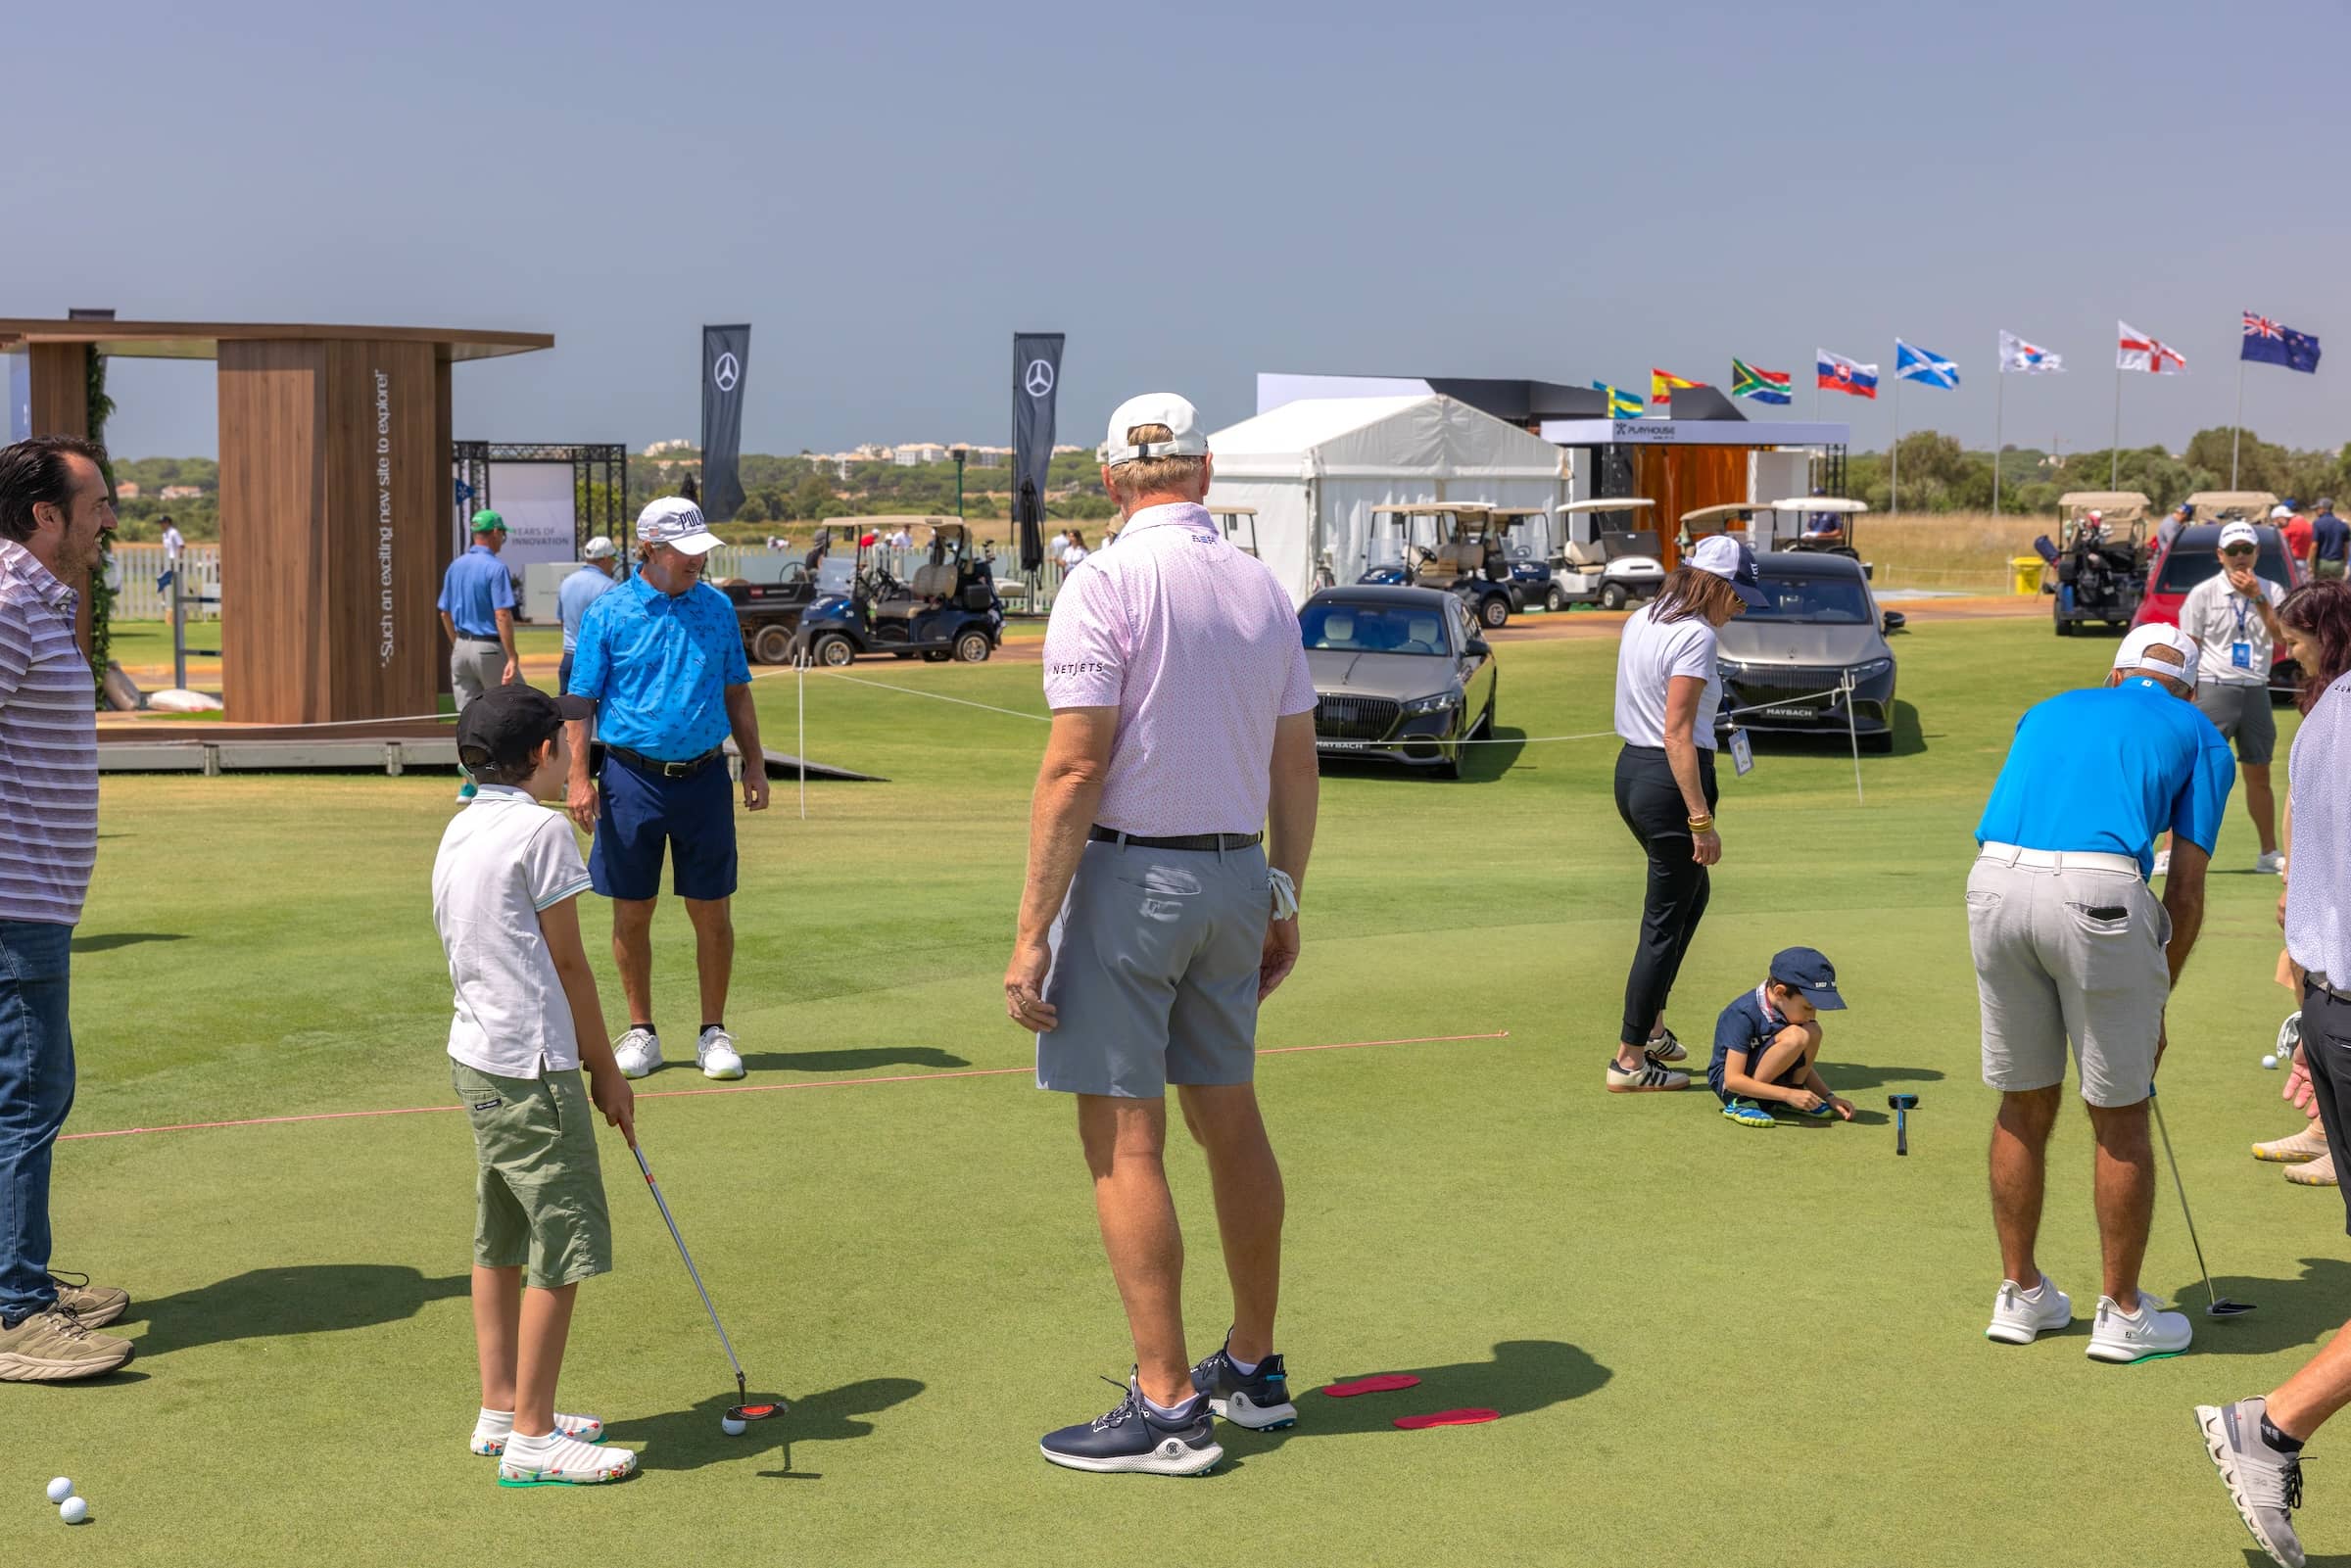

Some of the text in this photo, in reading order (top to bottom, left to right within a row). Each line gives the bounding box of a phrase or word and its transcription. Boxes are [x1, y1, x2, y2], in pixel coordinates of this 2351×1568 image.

[376, 438, 390, 453] to
[376, 456, 391, 487] site
[379, 488, 391, 523] new
[378, 526, 393, 587] exciting
[381, 590, 393, 610] an
[1053, 662, 1103, 676] NETJETS
[1766, 708, 1812, 717] MAYBACH
